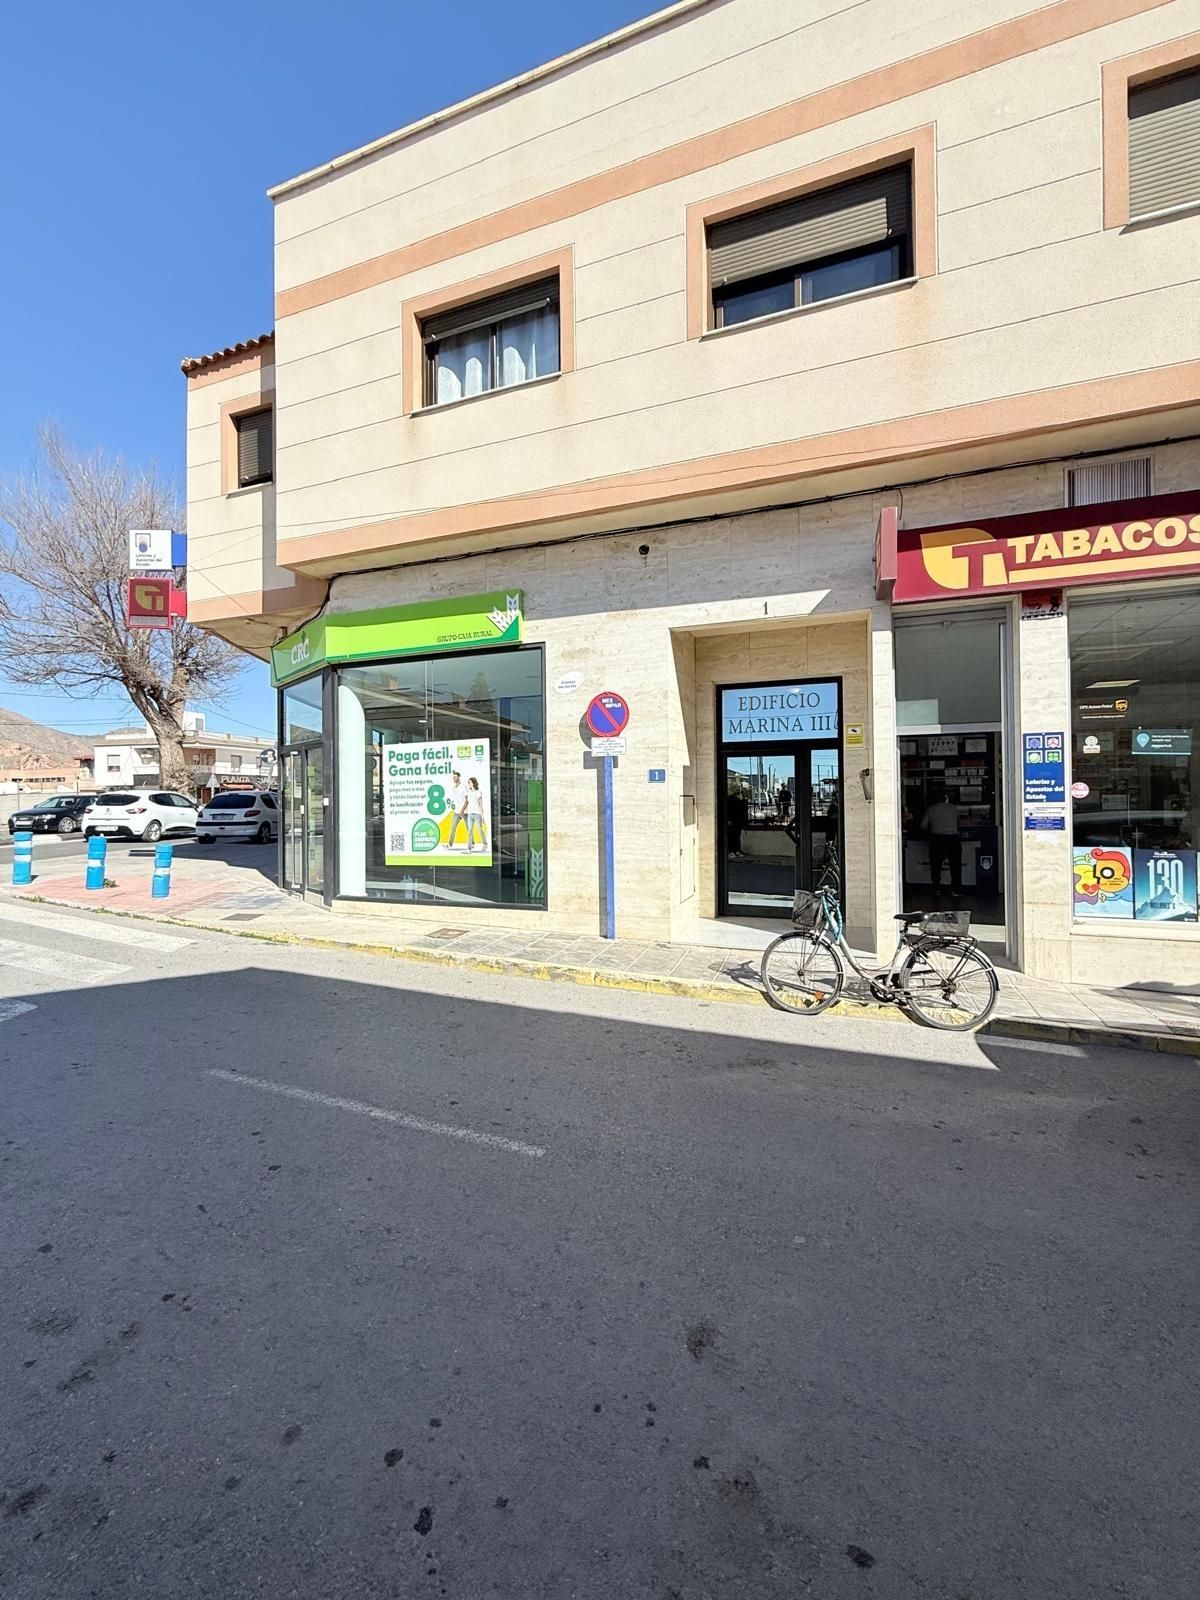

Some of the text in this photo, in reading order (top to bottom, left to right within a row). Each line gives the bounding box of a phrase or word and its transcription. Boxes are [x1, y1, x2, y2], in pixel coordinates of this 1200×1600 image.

[762, 601, 768, 615] 1
[437, 634, 457, 643] GRUPO
[473, 630, 494, 638] RURAL
[291, 639, 310, 665] CRC
[738, 692, 820, 712] EDIFICIO
[728, 715, 832, 734] MARINA III
[388, 750, 419, 764] Paga
[422, 746, 454, 761] fácil.
[220, 775, 251, 783] PLANTA
[389, 765, 422, 777] Gana
[655, 771, 660, 780] 1
[1147, 859, 1184, 901] 130
